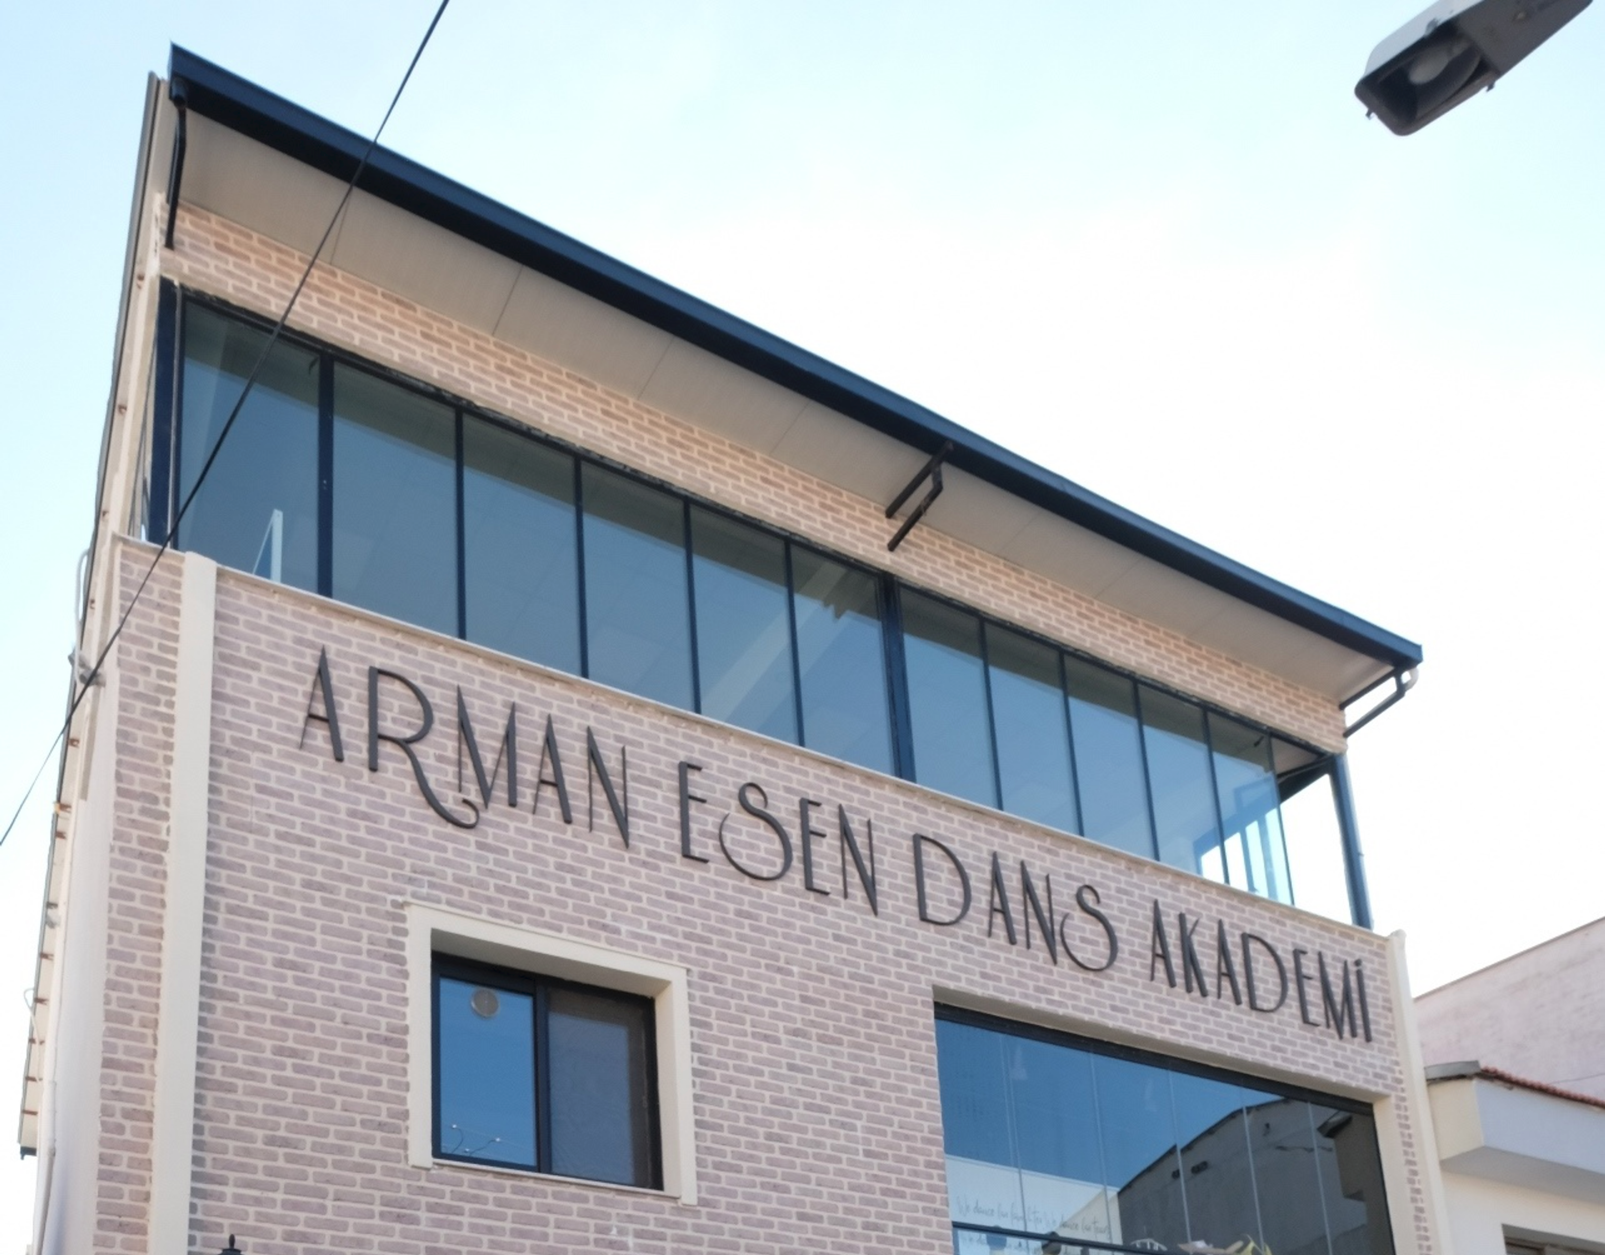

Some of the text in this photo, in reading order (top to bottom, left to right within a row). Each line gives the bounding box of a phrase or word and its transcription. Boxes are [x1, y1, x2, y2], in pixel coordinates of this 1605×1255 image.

[300, 645, 1373, 1043] ARMAN ESEN DANS AKADEMİ
